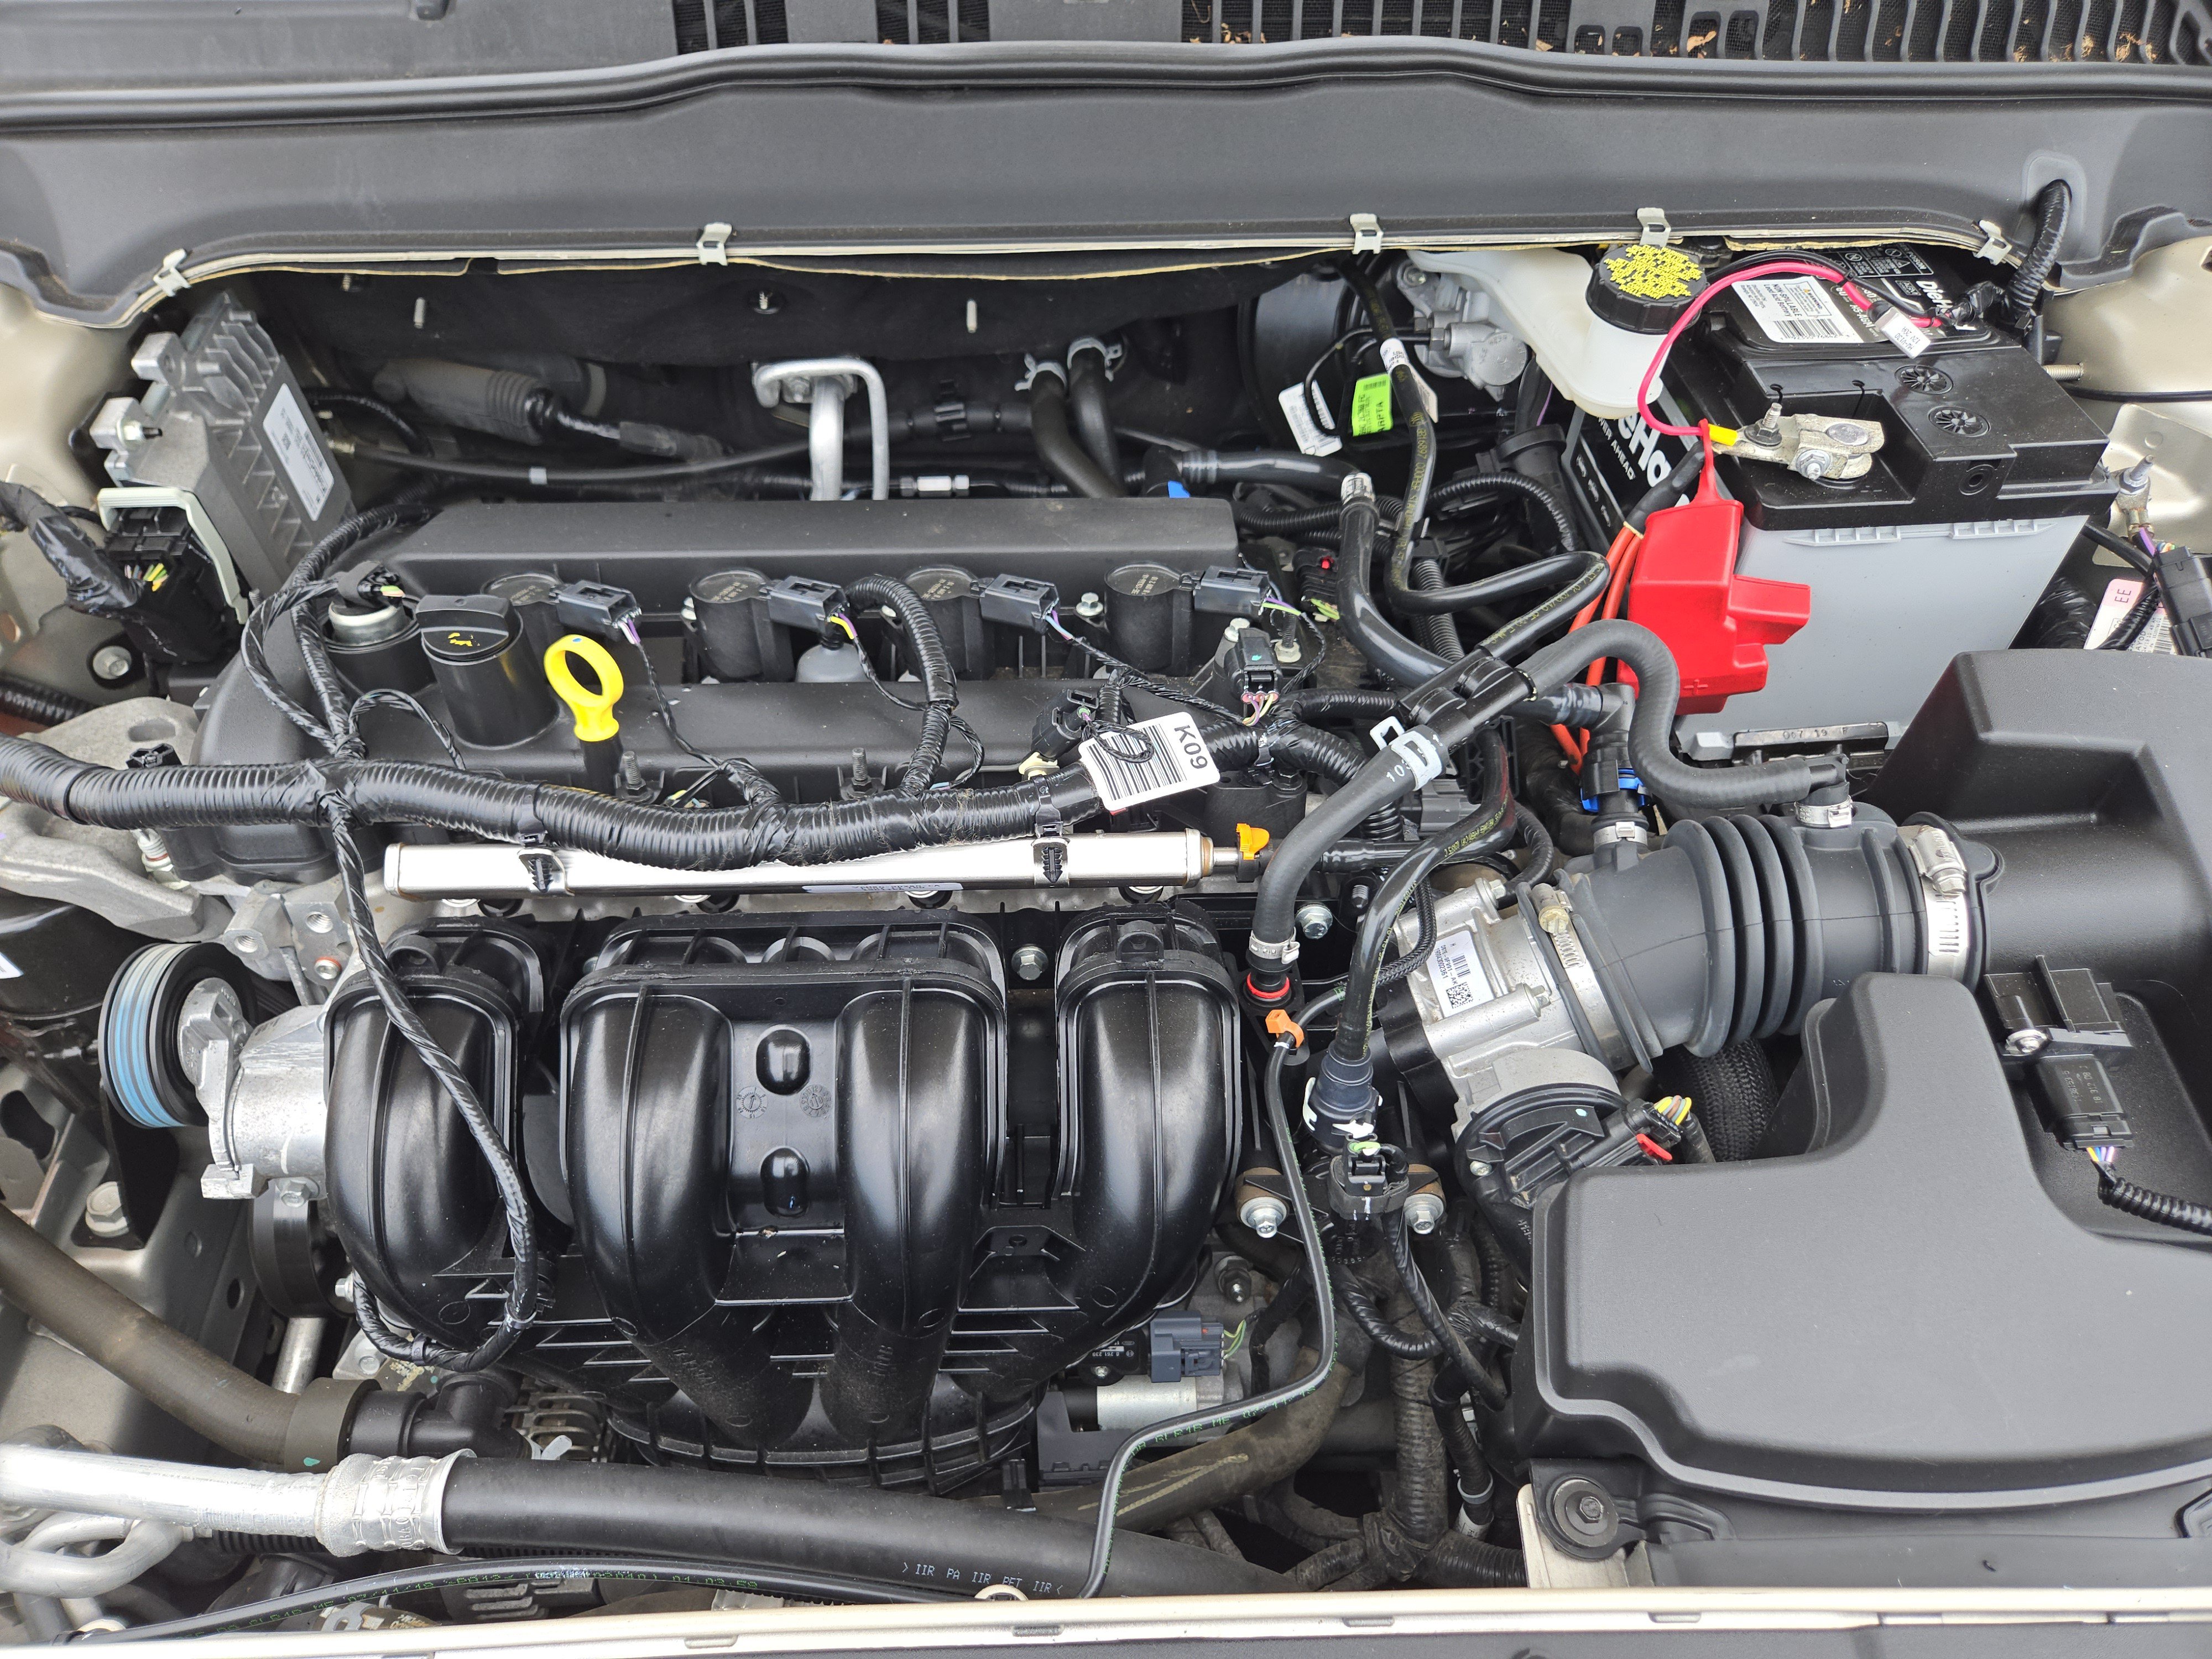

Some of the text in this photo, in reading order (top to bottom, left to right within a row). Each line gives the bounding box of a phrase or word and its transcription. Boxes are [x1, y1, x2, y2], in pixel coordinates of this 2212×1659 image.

[1772, 284, 1802, 317] NON-SPILLABLE
[1777, 301, 1792, 317] Battery
[1610, 439, 1636, 481] AHEAD
[2114, 588, 2132, 604] EE
[1174, 725, 1208, 769] K09
[915, 1564, 935, 1576] IIR
[946, 1567, 961, 1580] PA
[972, 1571, 992, 1584] IIR
[1032, 1580, 1052, 1593] IIR
